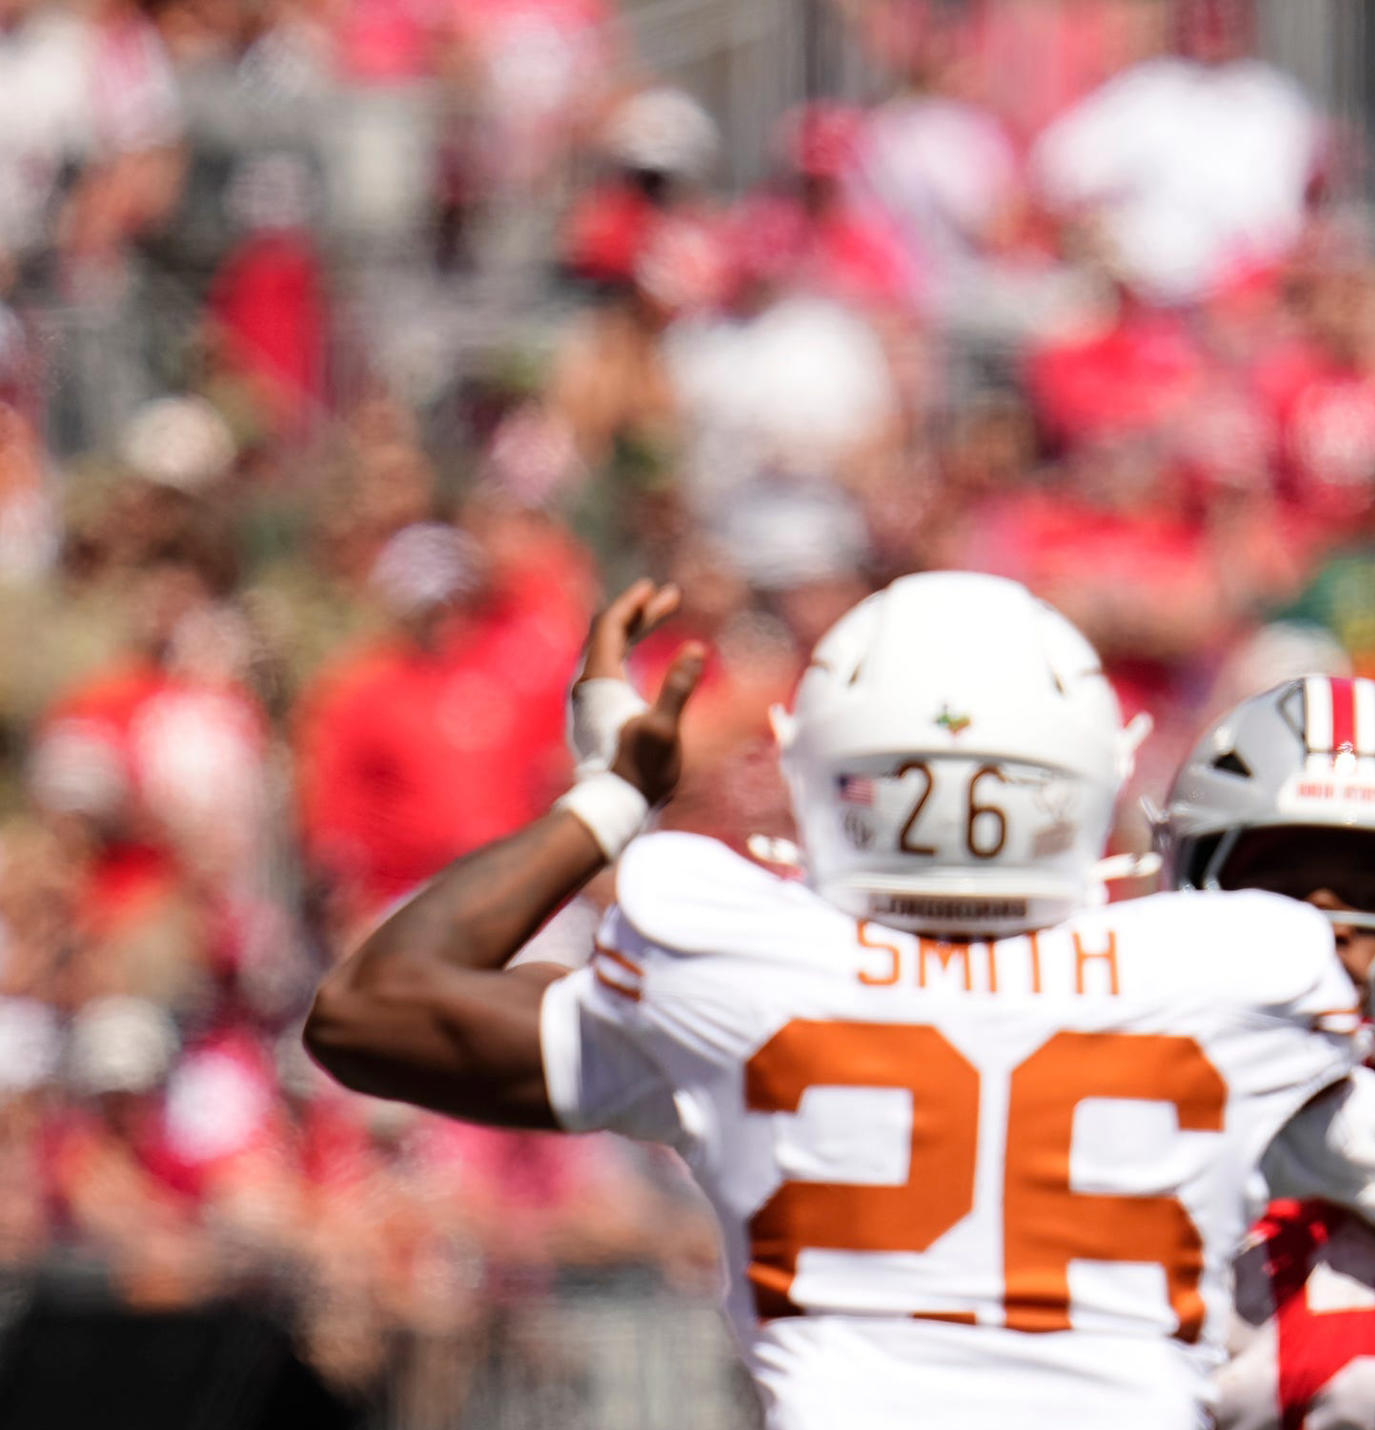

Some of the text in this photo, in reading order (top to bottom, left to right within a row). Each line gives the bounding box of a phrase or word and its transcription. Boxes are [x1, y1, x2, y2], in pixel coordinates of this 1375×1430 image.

[897, 761, 1007, 859] 26
[857, 919, 1119, 995] SMITH
[744, 1018, 1228, 1344] 26
